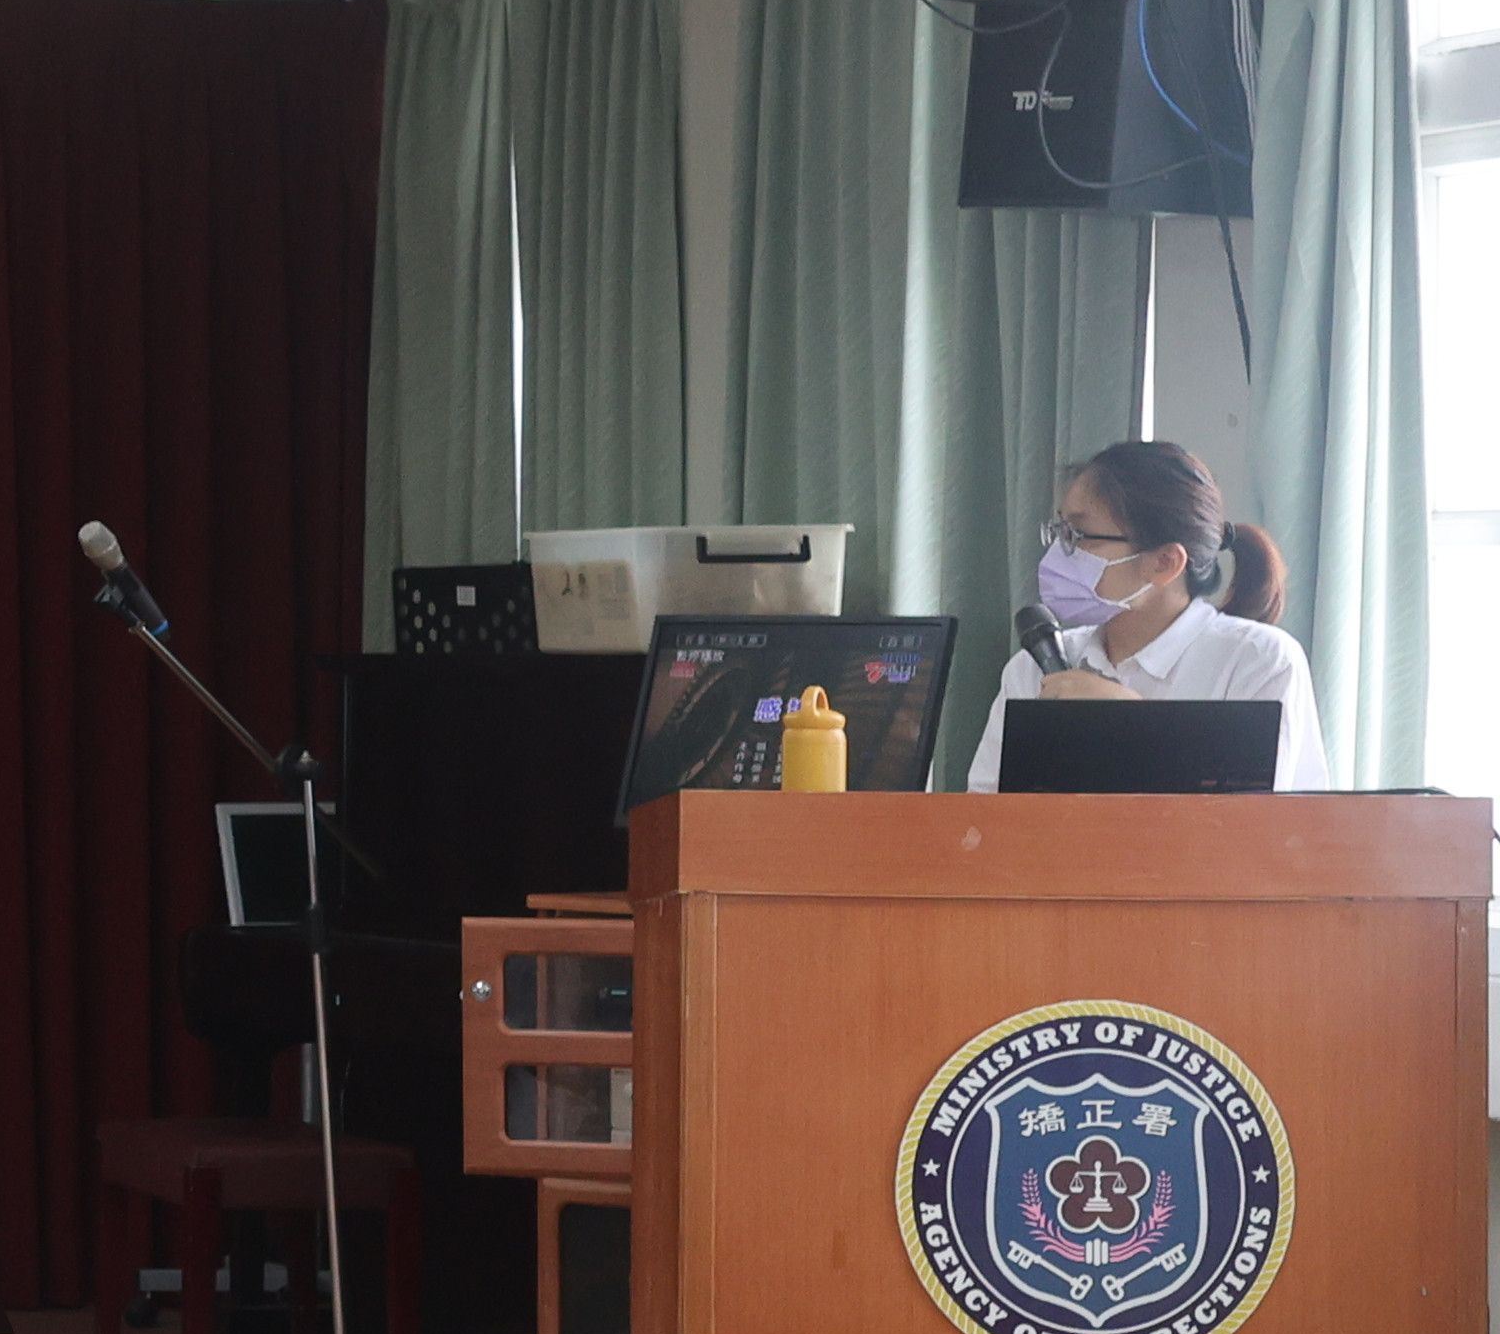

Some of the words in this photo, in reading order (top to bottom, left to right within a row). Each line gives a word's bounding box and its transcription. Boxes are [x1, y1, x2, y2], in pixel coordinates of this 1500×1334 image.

[930, 1021, 1083, 1137] MINISTRY
[1094, 1021, 1144, 1046] OF
[1148, 1033, 1263, 1143] JUSTICE
[1018, 1098, 1178, 1137] 矯正署
[918, 1200, 1009, 1329] AGENCY
